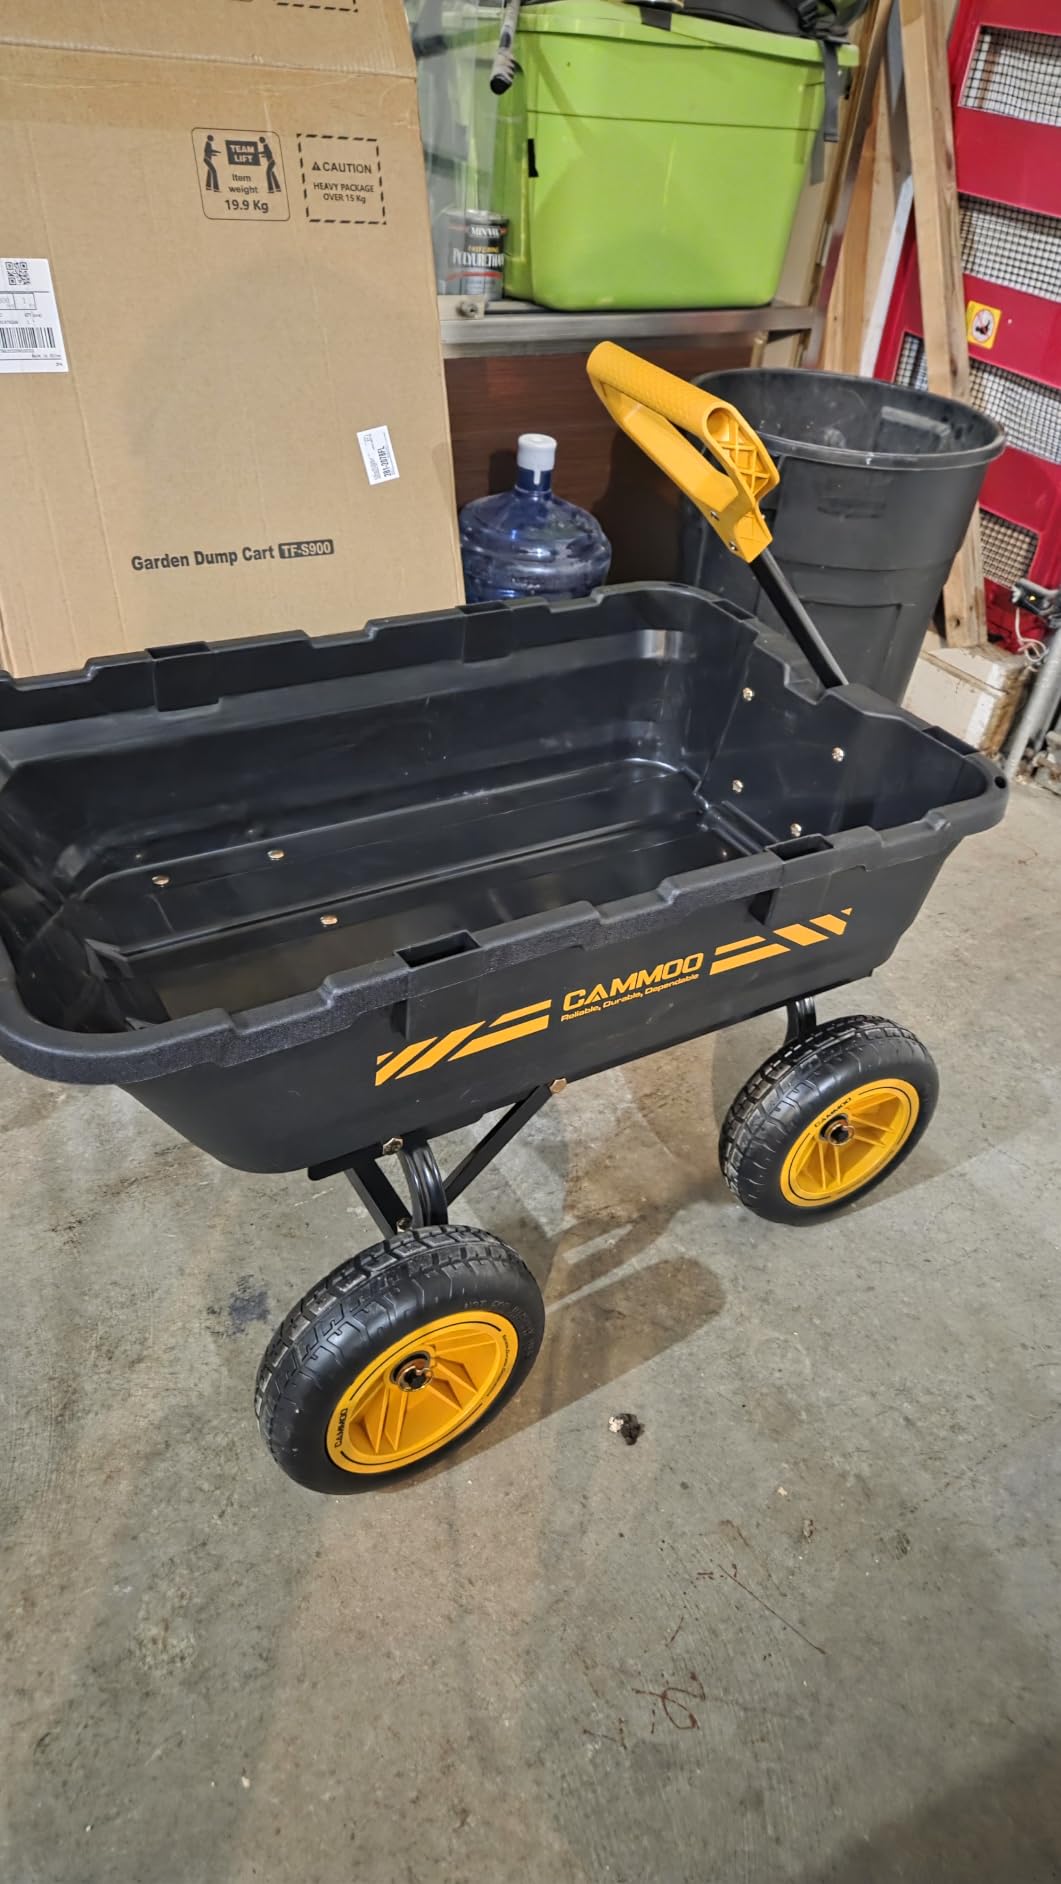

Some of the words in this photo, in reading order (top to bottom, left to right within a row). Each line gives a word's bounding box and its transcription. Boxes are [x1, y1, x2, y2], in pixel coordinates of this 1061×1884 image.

[229, 144, 255, 154] TEAM
[233, 154, 253, 163] LIFT
[322, 162, 372, 174] CAUTION
[231, 173, 252, 182] Item
[228, 184, 259, 195] weight
[313, 182, 339, 192] HEAVY
[340, 183, 375, 193] PACKAGE
[323, 193, 344, 202] OVER
[345, 194, 354, 202] 15
[354, 194, 366, 204] Kg
[224, 199, 250, 211] 19.9
[253, 200, 269, 214] Kg
[131, 553, 190, 571] Garden
[193, 550, 238, 567] Dump
[242, 545, 275, 562] Cart
[281, 541, 332, 558] TF-S900
[562, 952, 704, 1012] CAMMOO
[560, 1006, 602, 1022] Reliable,
[602, 992, 644, 1009] Durable,
[644, 973, 700, 995] Dependable
